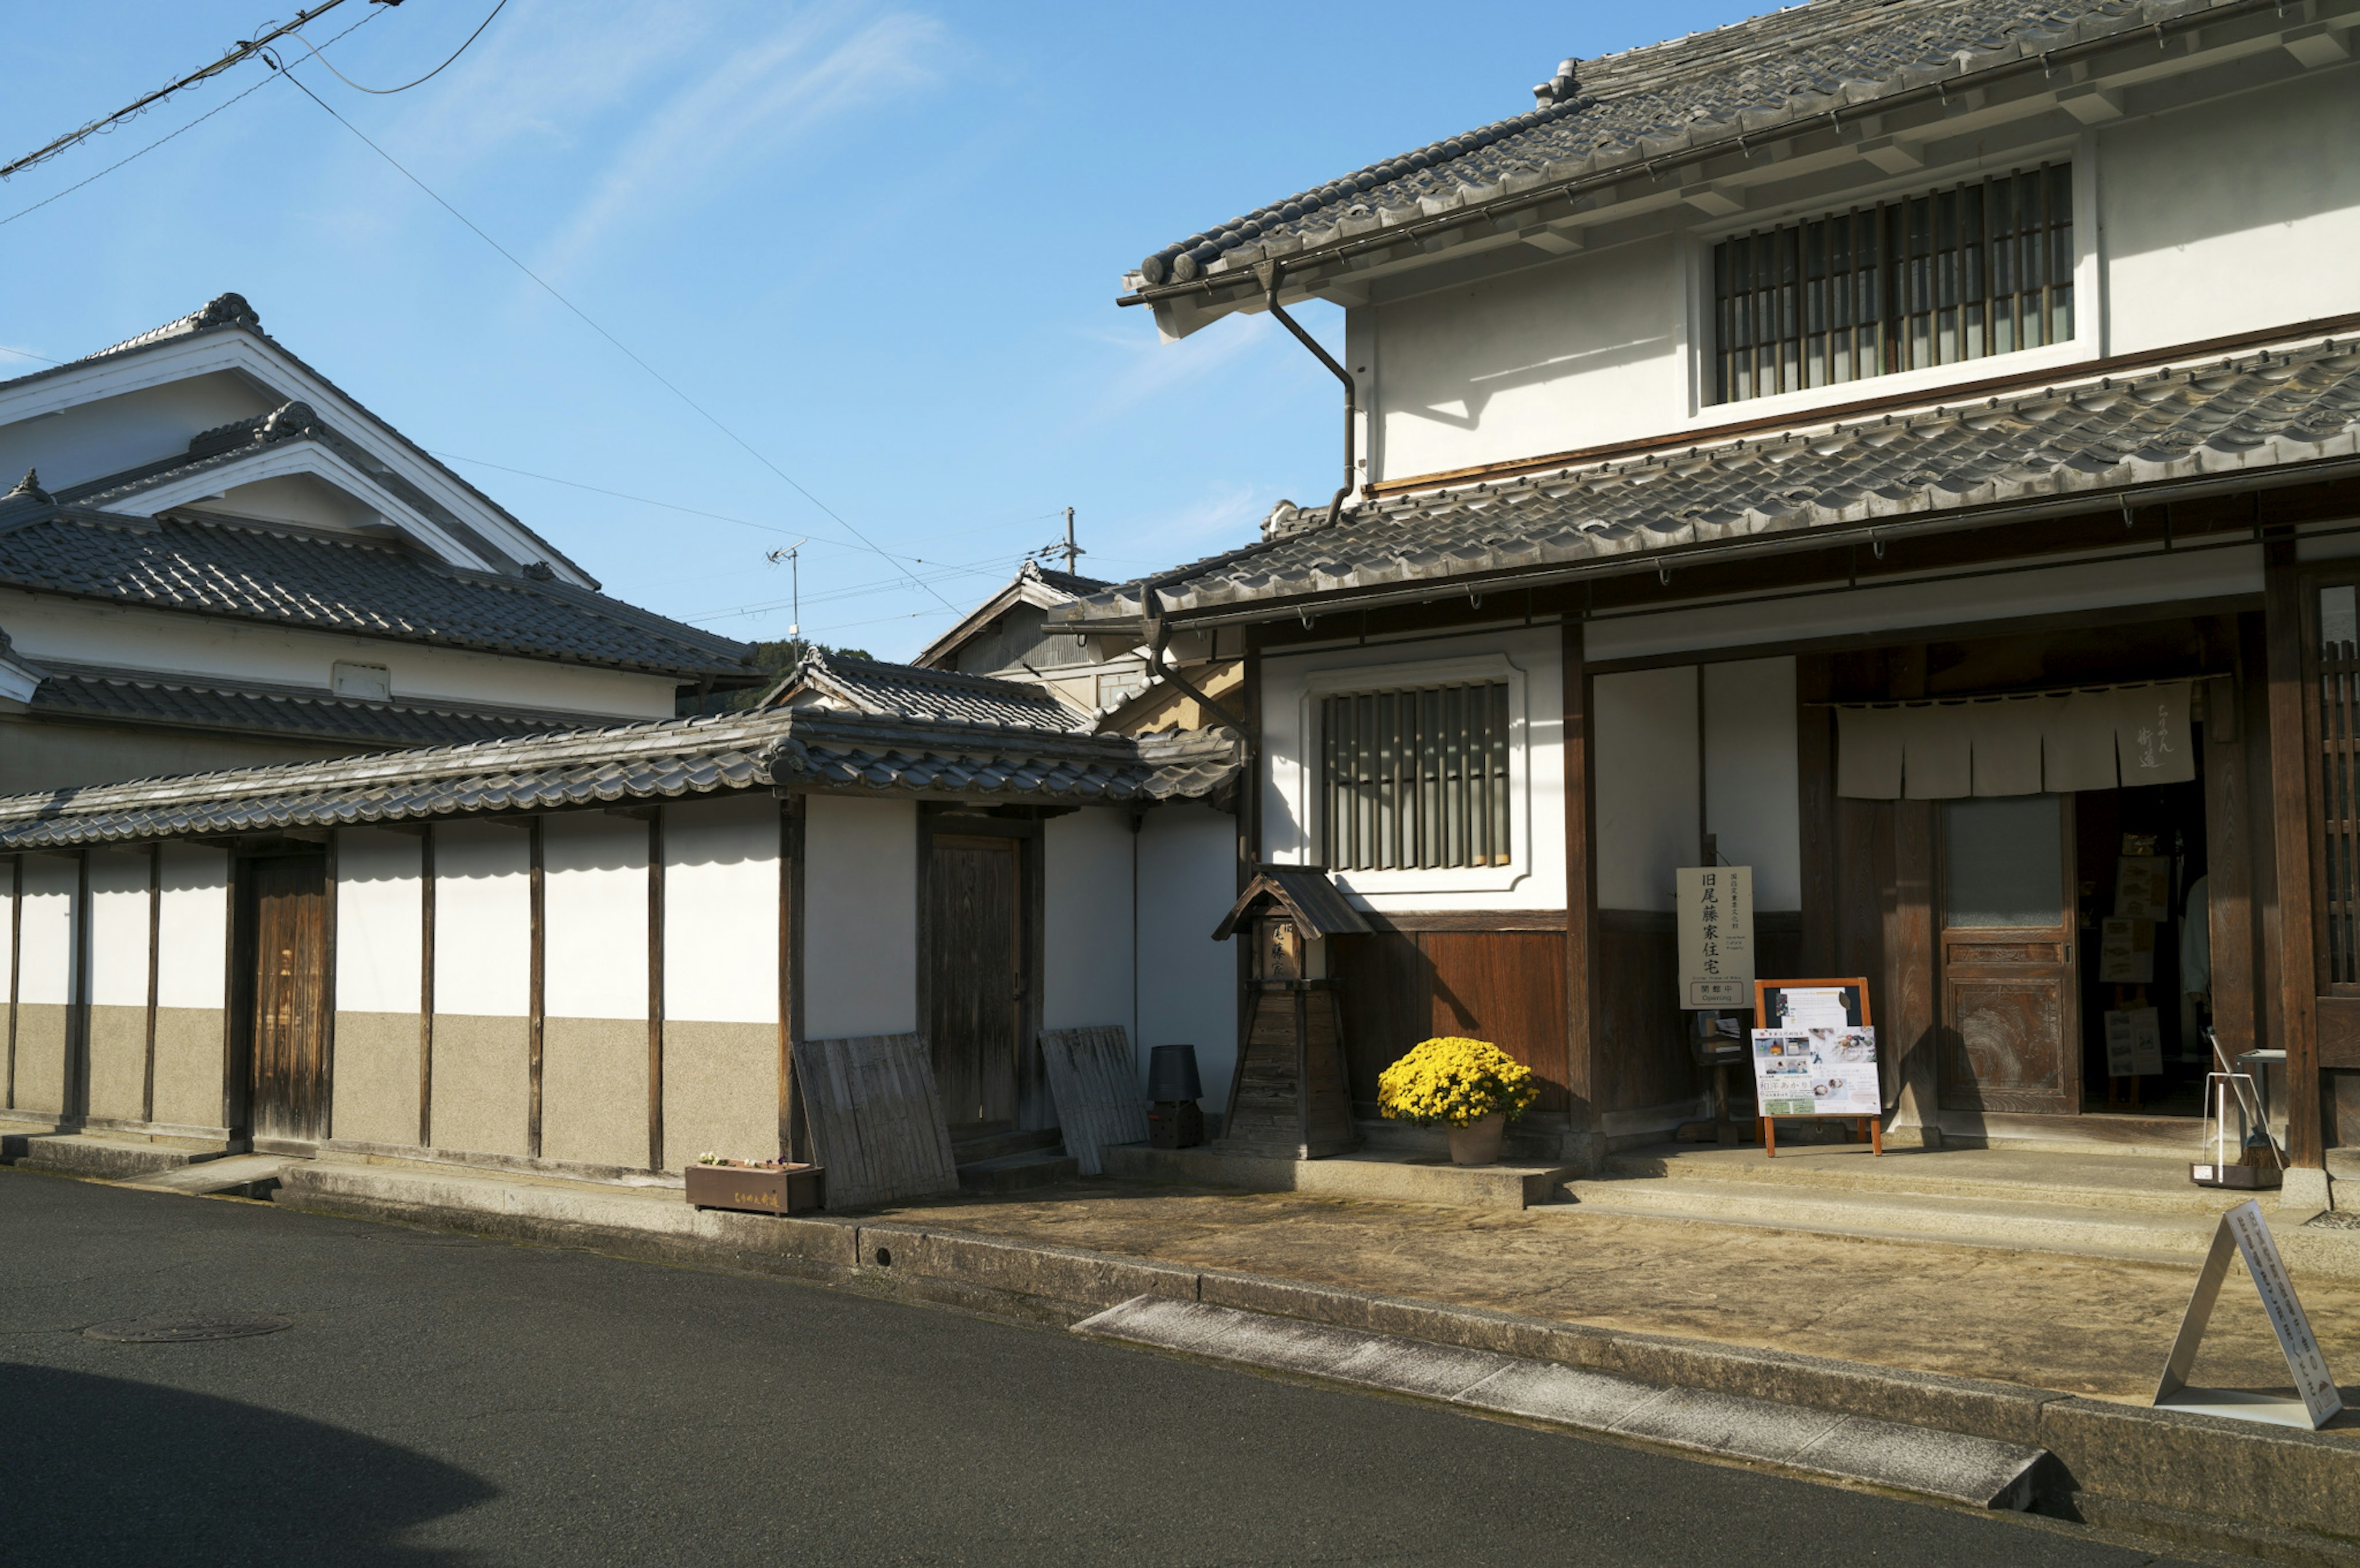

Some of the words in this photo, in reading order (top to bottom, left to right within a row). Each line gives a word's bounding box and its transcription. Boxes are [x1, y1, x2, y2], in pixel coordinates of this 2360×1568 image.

[2138, 727, 2166, 767] 街道
[2158, 705, 2174, 753] ちりめん
[1701, 873, 1719, 974] 旧尾藤家住宅
[734, 1192, 780, 1208] ちりめん街道
